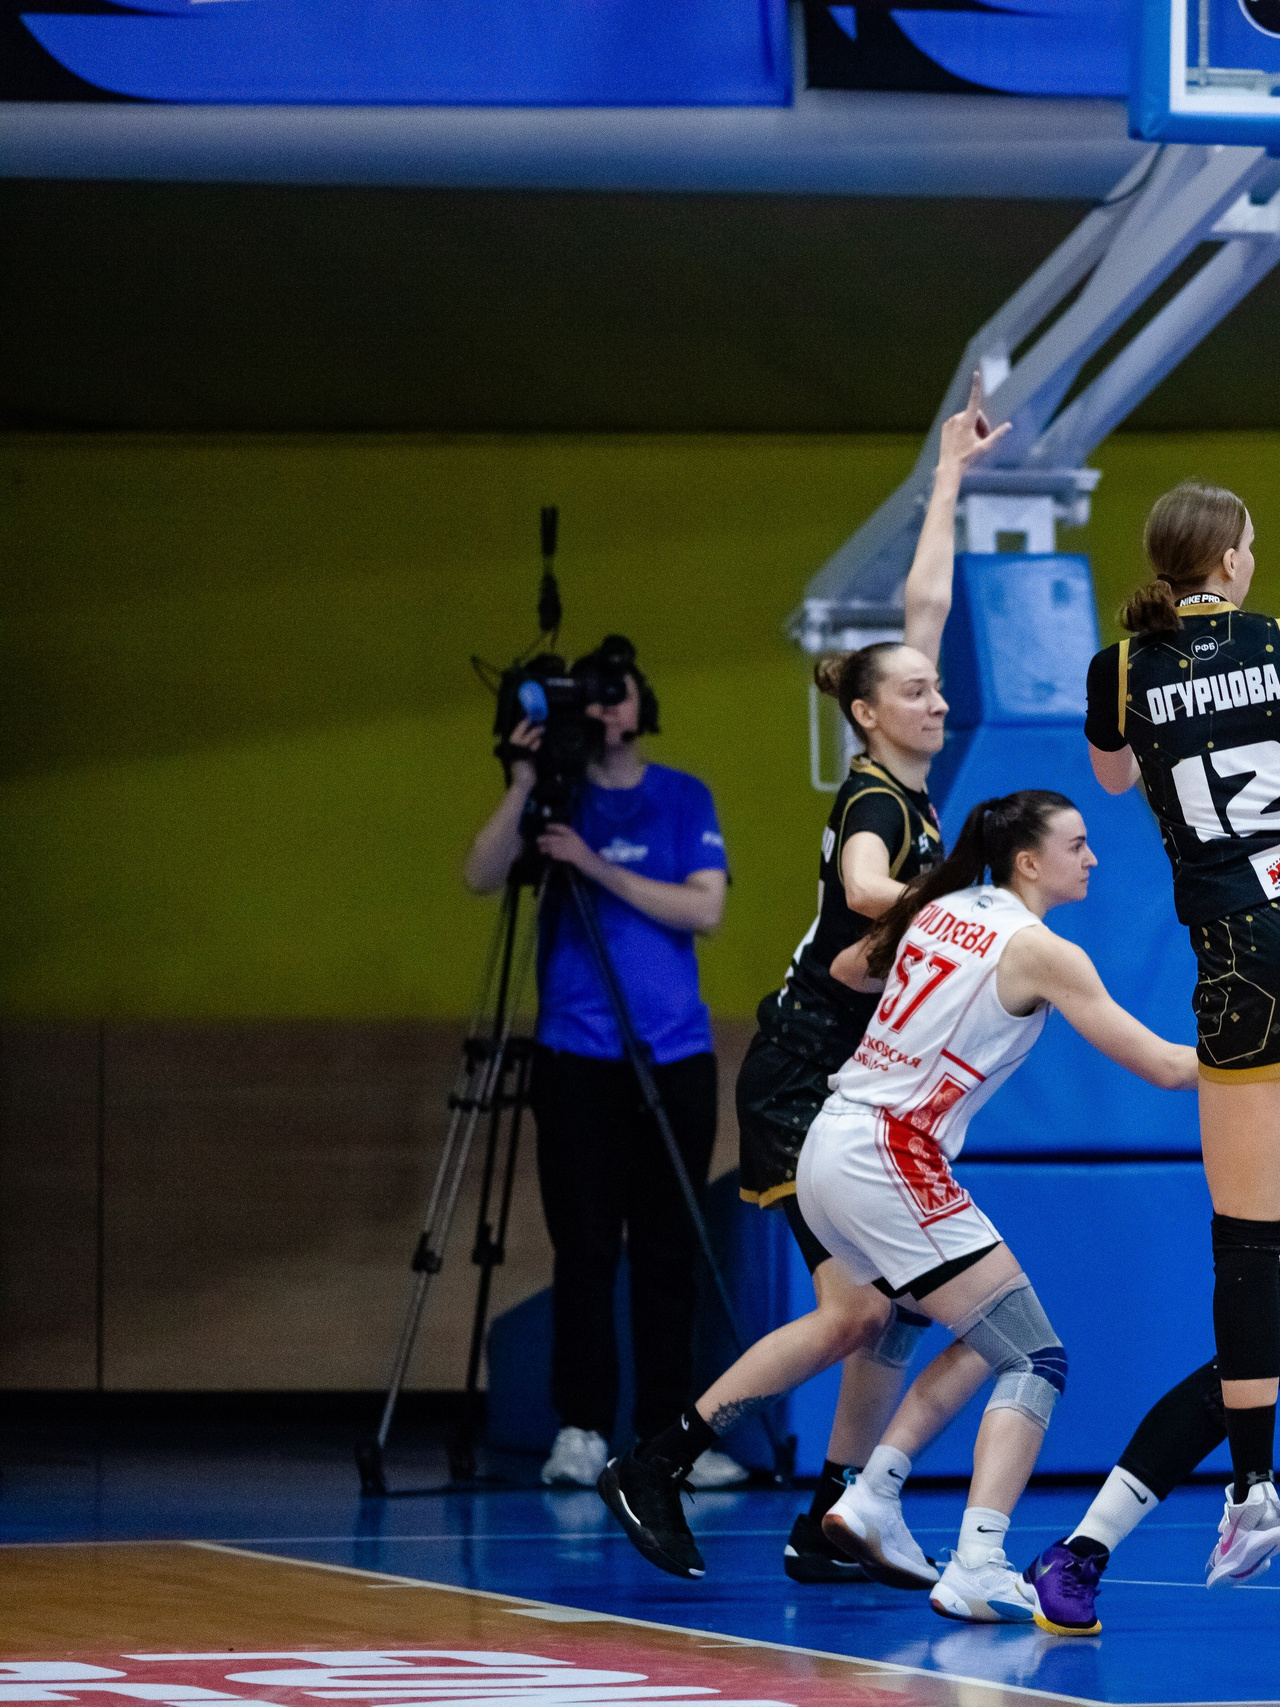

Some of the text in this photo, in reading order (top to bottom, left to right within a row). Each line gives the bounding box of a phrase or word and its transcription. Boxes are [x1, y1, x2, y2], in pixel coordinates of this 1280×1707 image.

[1180, 594, 1201, 607] NIKE
[1194, 642, 1216, 653] РФБ
[877, 941, 961, 1034] 57
